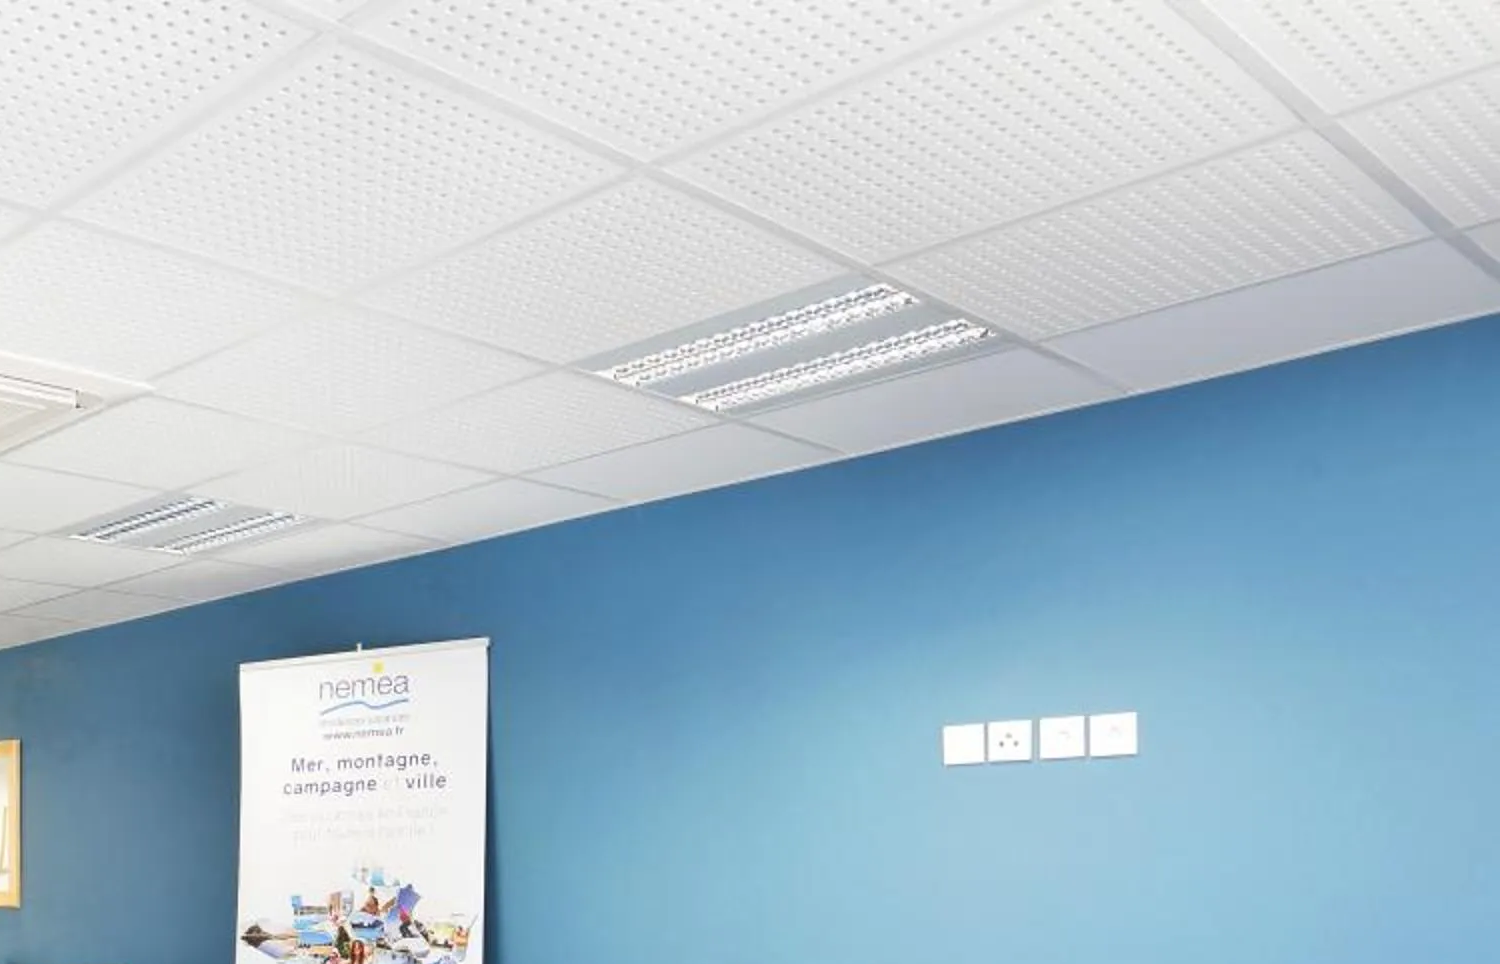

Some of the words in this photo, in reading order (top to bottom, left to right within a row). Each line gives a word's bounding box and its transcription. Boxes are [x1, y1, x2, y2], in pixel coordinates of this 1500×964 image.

[319, 675, 409, 700] nemea
[291, 757, 330, 773] Mer,
[337, 753, 439, 772] montagne,
[283, 778, 378, 797] campagne
[405, 773, 447, 790] ville
